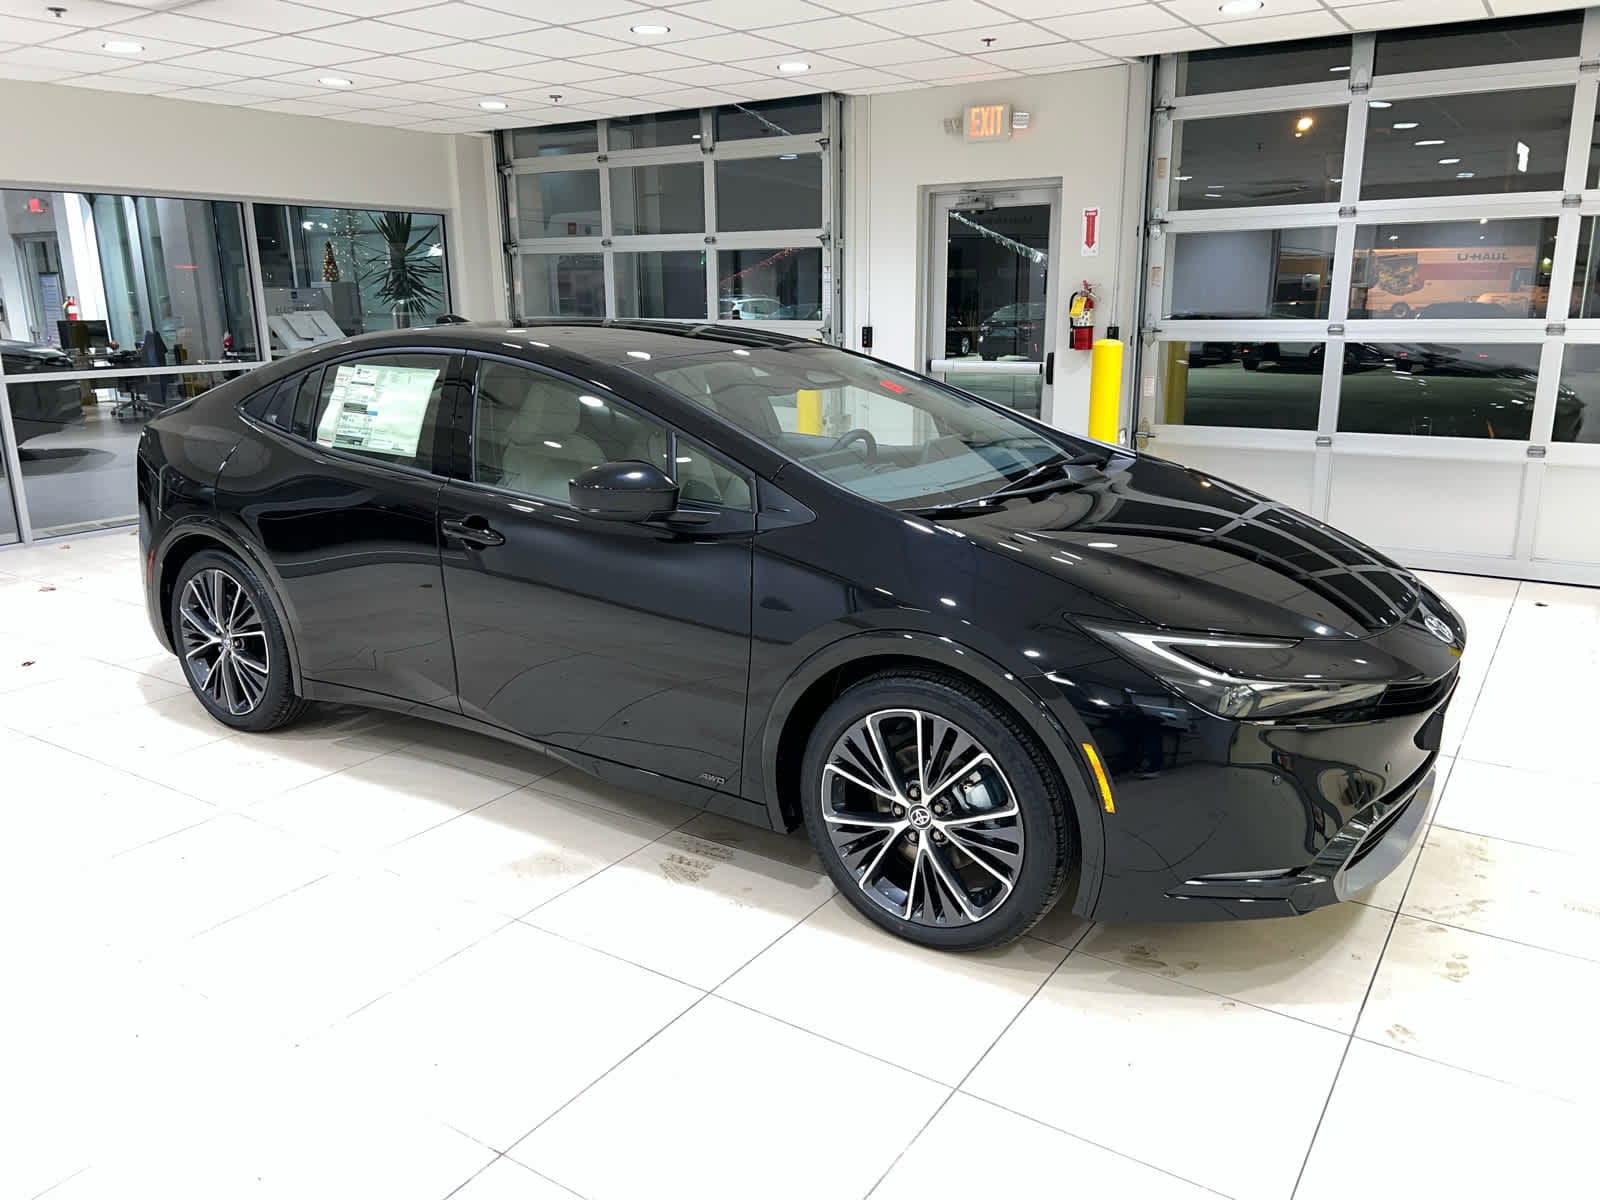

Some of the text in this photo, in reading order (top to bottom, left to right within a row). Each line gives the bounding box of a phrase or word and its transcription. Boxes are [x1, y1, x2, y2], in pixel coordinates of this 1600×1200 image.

[969, 105, 1004, 137] EXIT
[1457, 252, 1509, 262] U-HAUL
[699, 773, 726, 785] AWD
